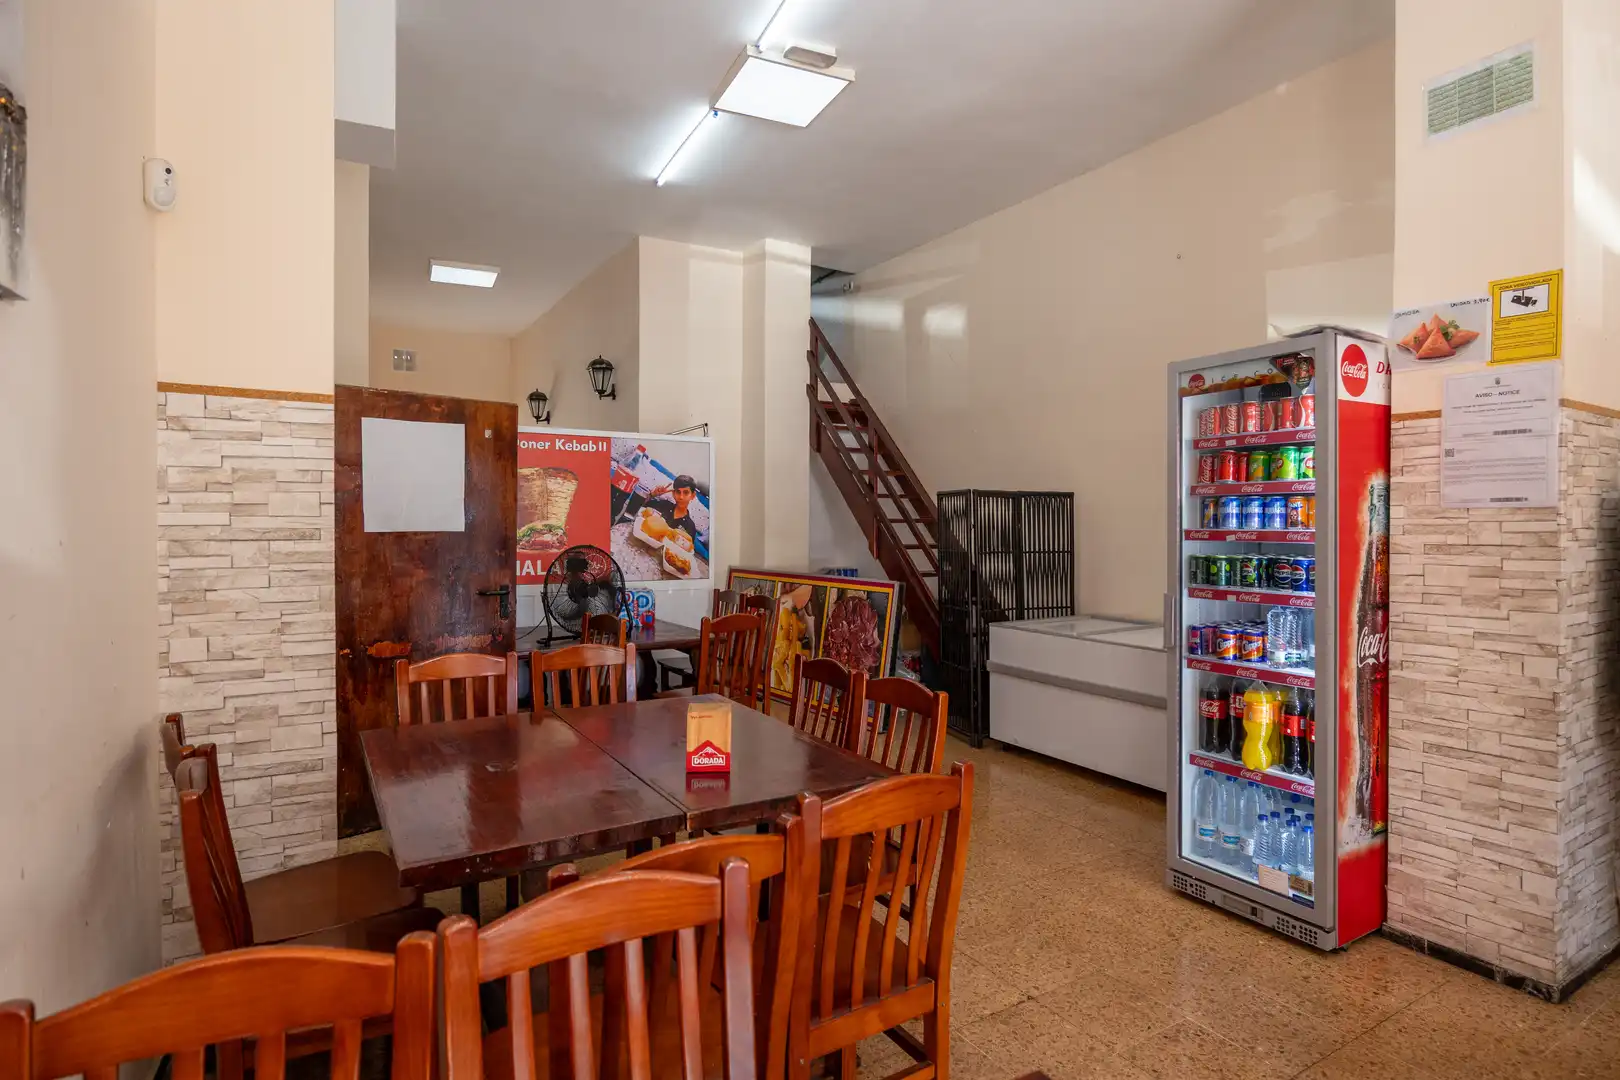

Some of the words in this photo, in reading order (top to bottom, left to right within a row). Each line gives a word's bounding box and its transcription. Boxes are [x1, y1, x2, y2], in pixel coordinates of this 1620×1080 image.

[1341, 360, 1367, 379] Coca-Cola
[1498, 389, 1520, 397] NOTICE
[1199, 439, 1219, 448] Coca-Cola
[1245, 435, 1267, 444] Coca-Cola
[517, 439, 550, 450] oner
[555, 438, 596, 452] Kebab
[1196, 486, 1216, 494] Coca-Cola
[1241, 484, 1264, 493] Coca-Cola
[1190, 530, 1210, 539] Coca-Cola
[1236, 531, 1257, 540] Coca-Cola
[1287, 532, 1310, 541] Coca-Cola
[516, 559, 568, 576] ALA
[1193, 590, 1213, 599] Coca-Cola
[1239, 593, 1260, 603] Coca-Cola
[1290, 597, 1314, 607] Coca-Cola
[1192, 661, 1211, 671] Coca-Cola
[1237, 668, 1258, 678] Coca-Cola
[1287, 675, 1310, 687] Coca-Cola
[1195, 757, 1214, 768] Coca-Cola
[1241, 769, 1262, 781] Coca-Cola
